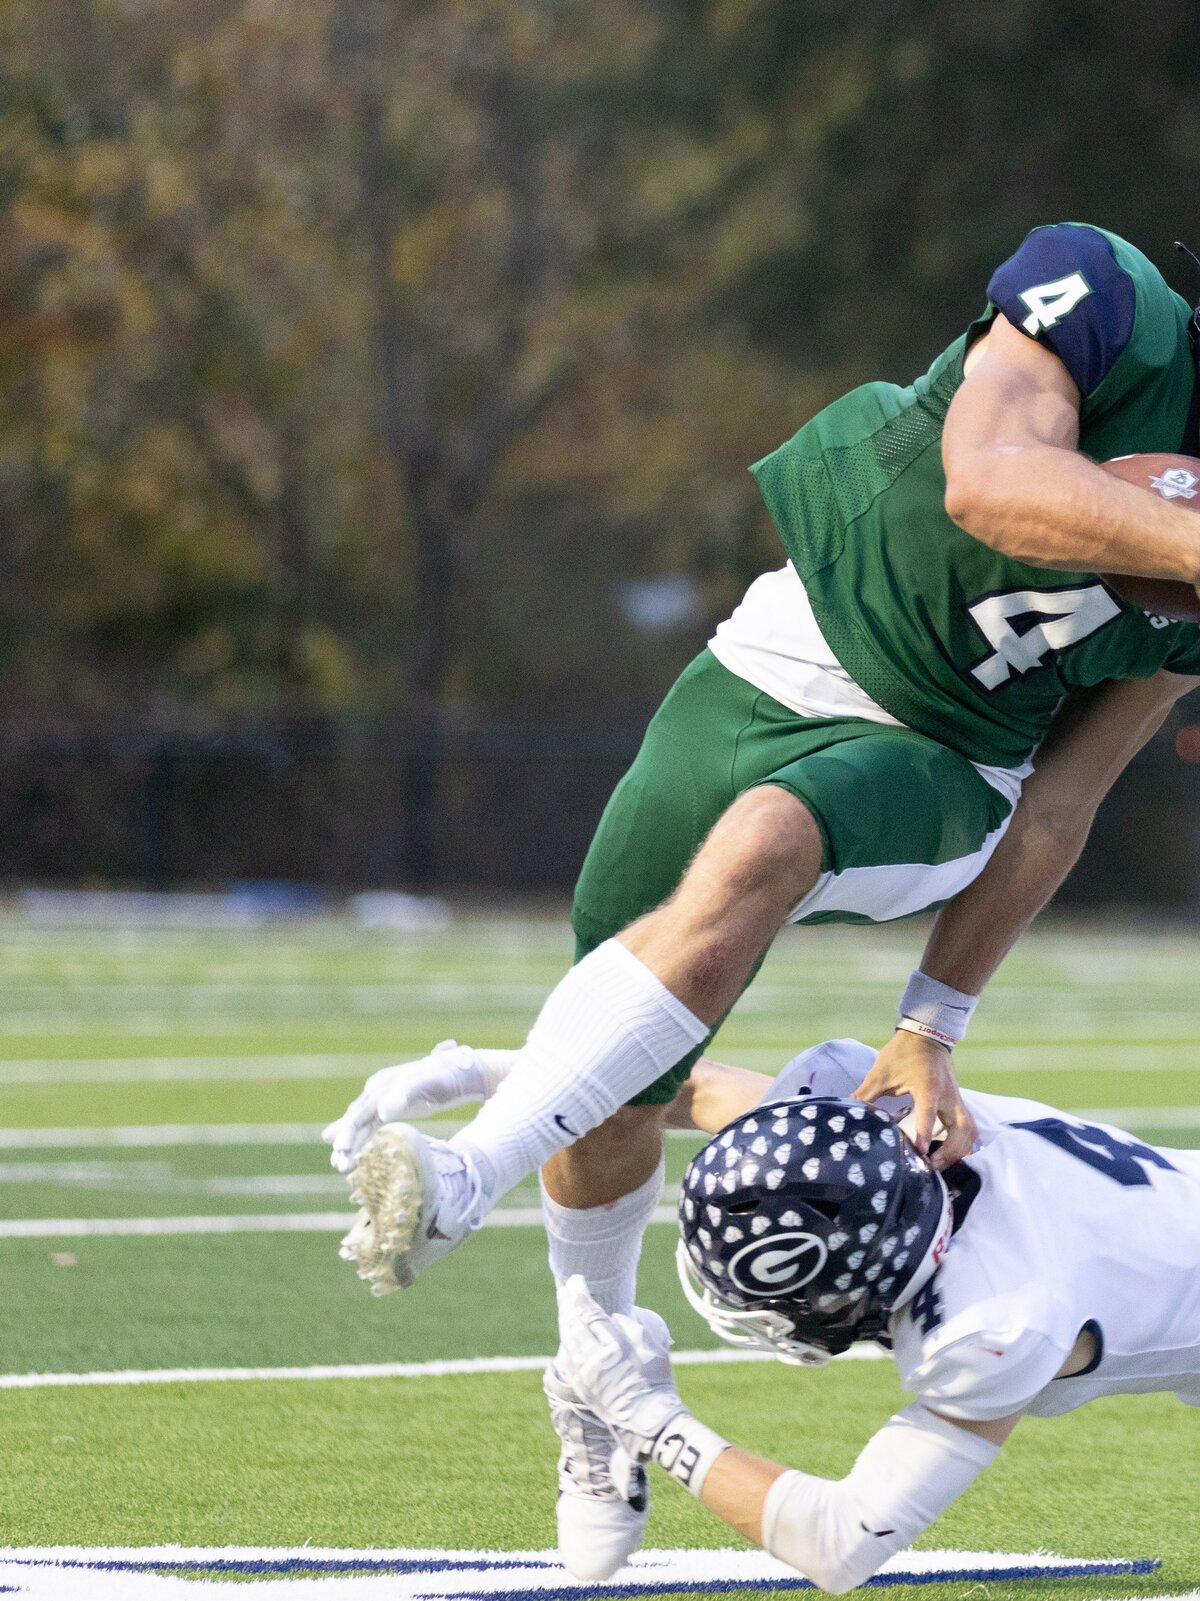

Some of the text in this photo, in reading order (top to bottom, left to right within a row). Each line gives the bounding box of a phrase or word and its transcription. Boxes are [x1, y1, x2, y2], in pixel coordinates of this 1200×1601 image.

[1017, 270, 1092, 339] 4
[967, 582, 1123, 692] 4
[1005, 1117, 1180, 1188] 4
[738, 1234, 823, 1291] G
